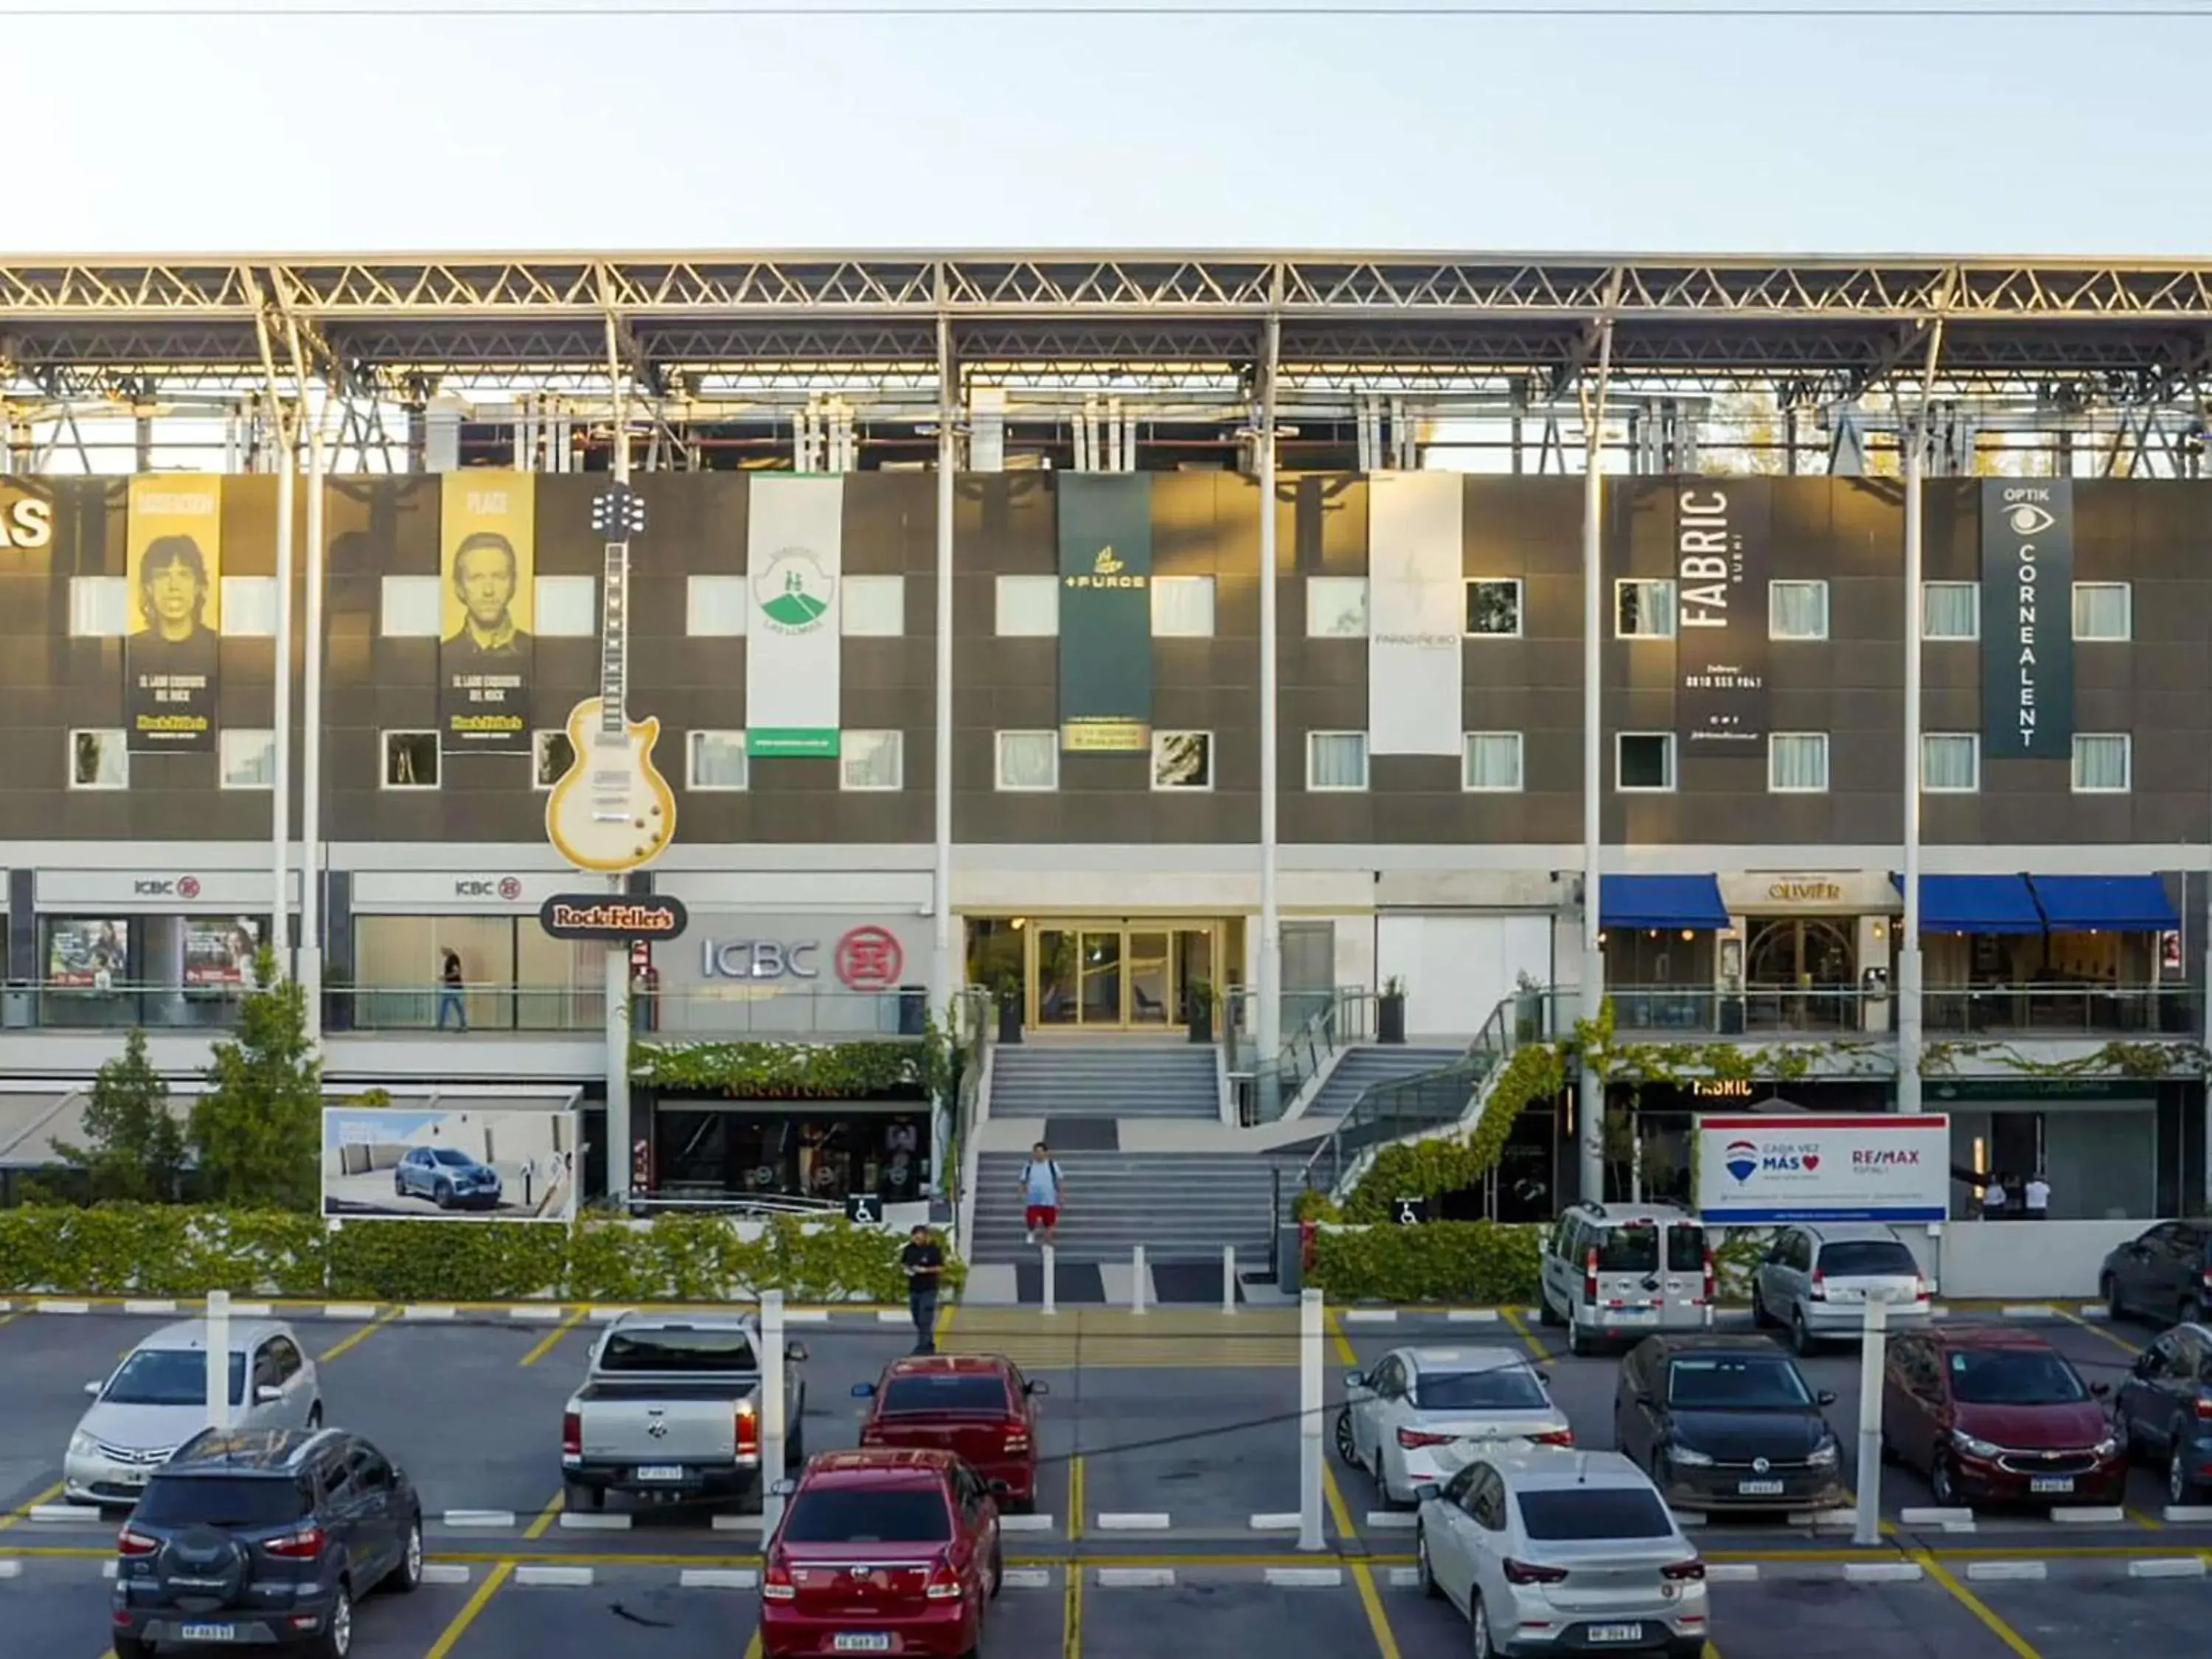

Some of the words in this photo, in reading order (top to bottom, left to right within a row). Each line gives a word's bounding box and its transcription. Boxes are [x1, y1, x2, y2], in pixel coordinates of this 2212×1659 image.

[2003, 488, 2049, 501] OPTIK
[0, 498, 51, 547] S
[1680, 491, 1727, 627] FABRIC
[2019, 544, 2037, 747] CORNEALENT
[135, 880, 173, 894] ICBC
[455, 880, 493, 896] ICBC
[703, 938, 820, 978] ICBC
[1763, 1155, 1799, 1170] MÁS
[1853, 1150, 1919, 1164] RE/MAX
